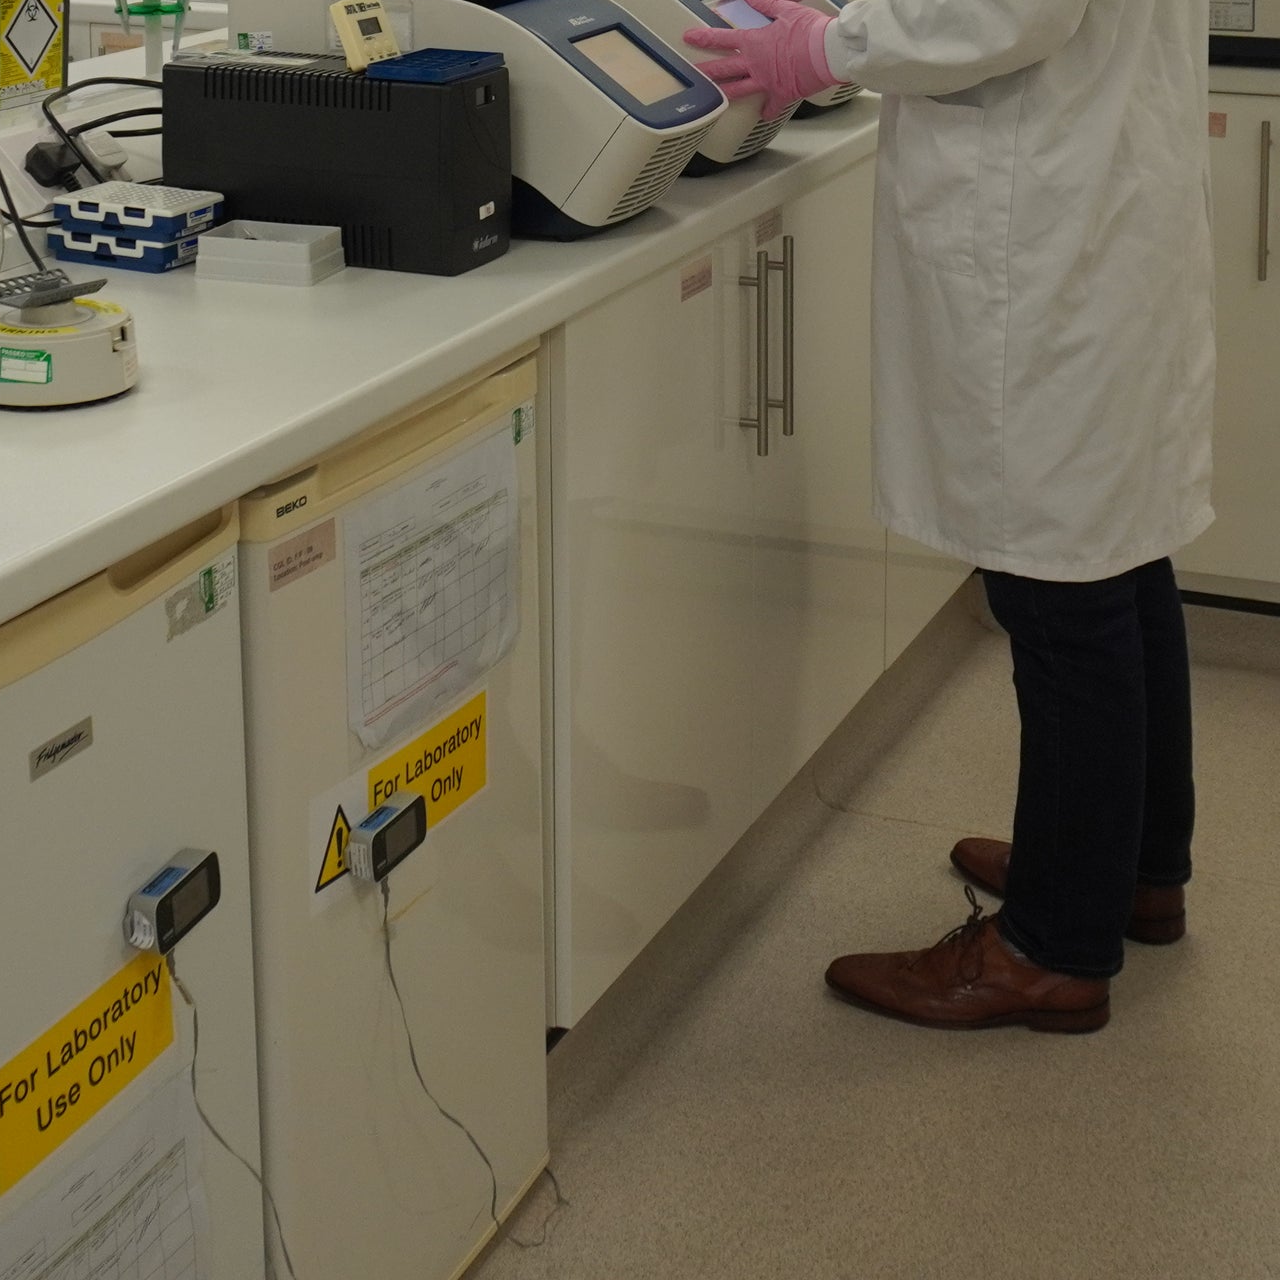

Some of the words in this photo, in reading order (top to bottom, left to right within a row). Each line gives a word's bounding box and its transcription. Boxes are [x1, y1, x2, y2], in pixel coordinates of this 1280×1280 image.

[276, 495, 308, 518] BEKO
[373, 773, 400, 807] For
[405, 714, 482, 785] Laboratory
[431, 765, 464, 803] Only
[45, 962, 162, 1078] Laboratory
[37, 1081, 80, 1132] Use
[88, 1029, 138, 1086] Only
